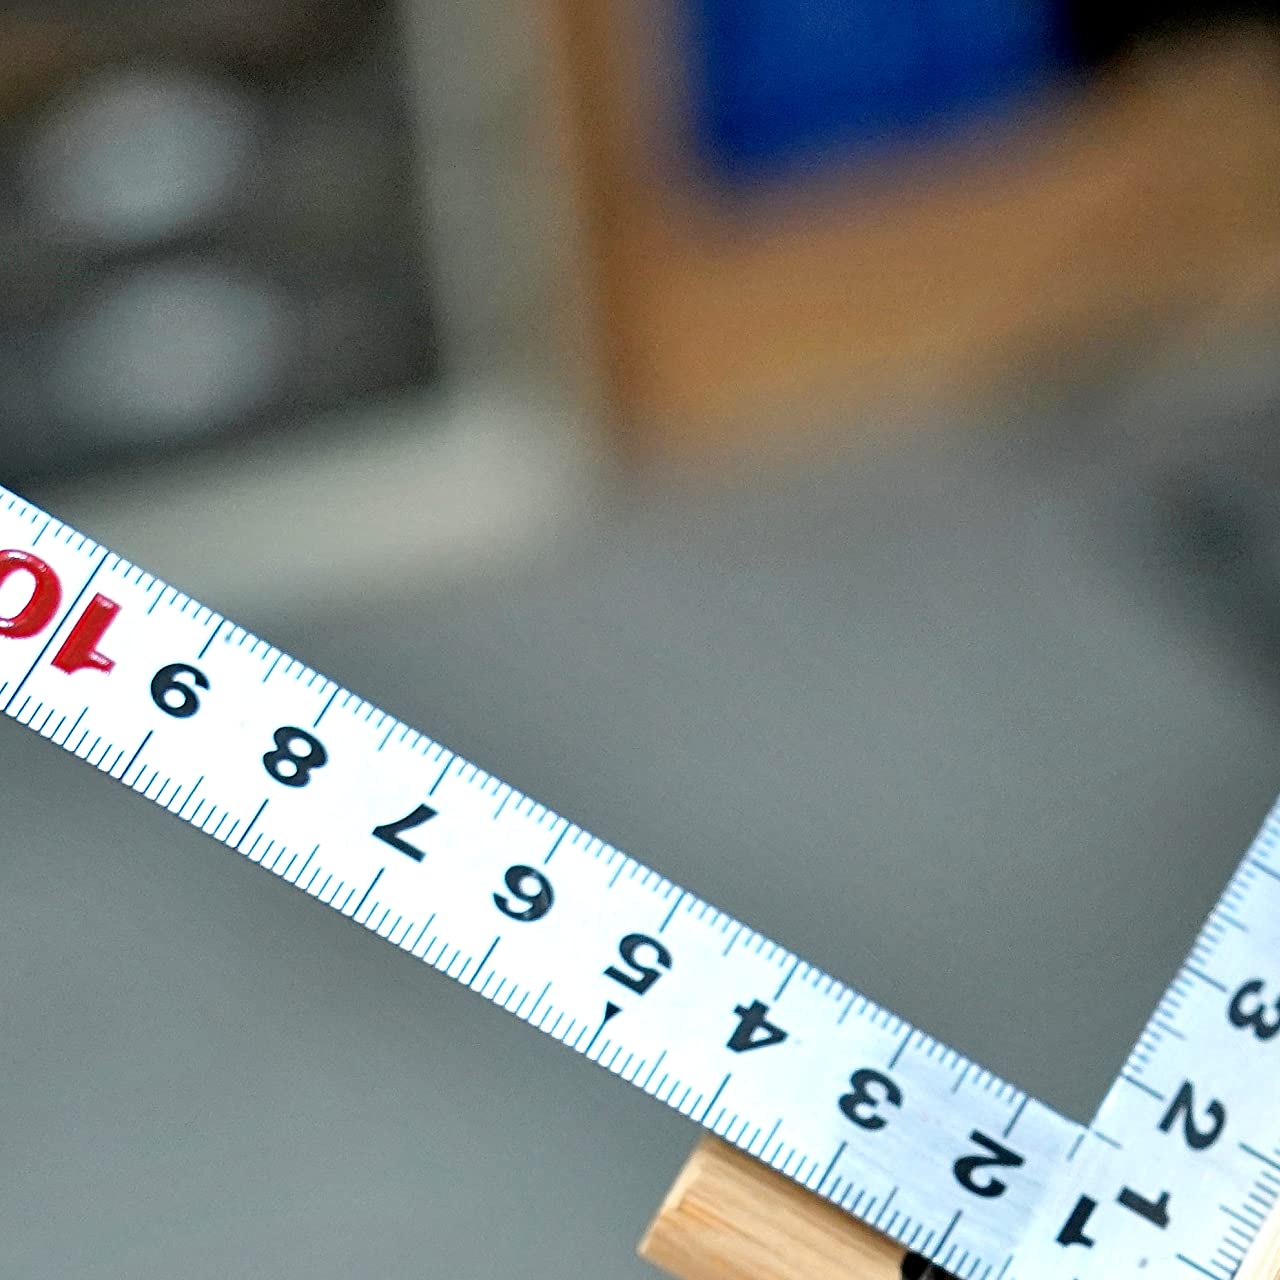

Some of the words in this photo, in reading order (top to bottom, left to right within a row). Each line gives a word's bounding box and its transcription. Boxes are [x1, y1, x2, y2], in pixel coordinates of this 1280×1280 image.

[0, 548, 122, 677] 10
[149, 662, 211, 719] 9
[261, 725, 329, 789] 8
[371, 802, 438, 863] 7
[492, 863, 555, 923] 6
[602, 932, 673, 996] 5
[725, 999, 788, 1054] 4
[837, 1067, 903, 1131] 3
[1158, 1081, 1226, 1151] 2
[952, 1129, 1025, 1199] 2
[1055, 1194, 1098, 1249] 1
[1116, 1186, 1170, 1229] 1
